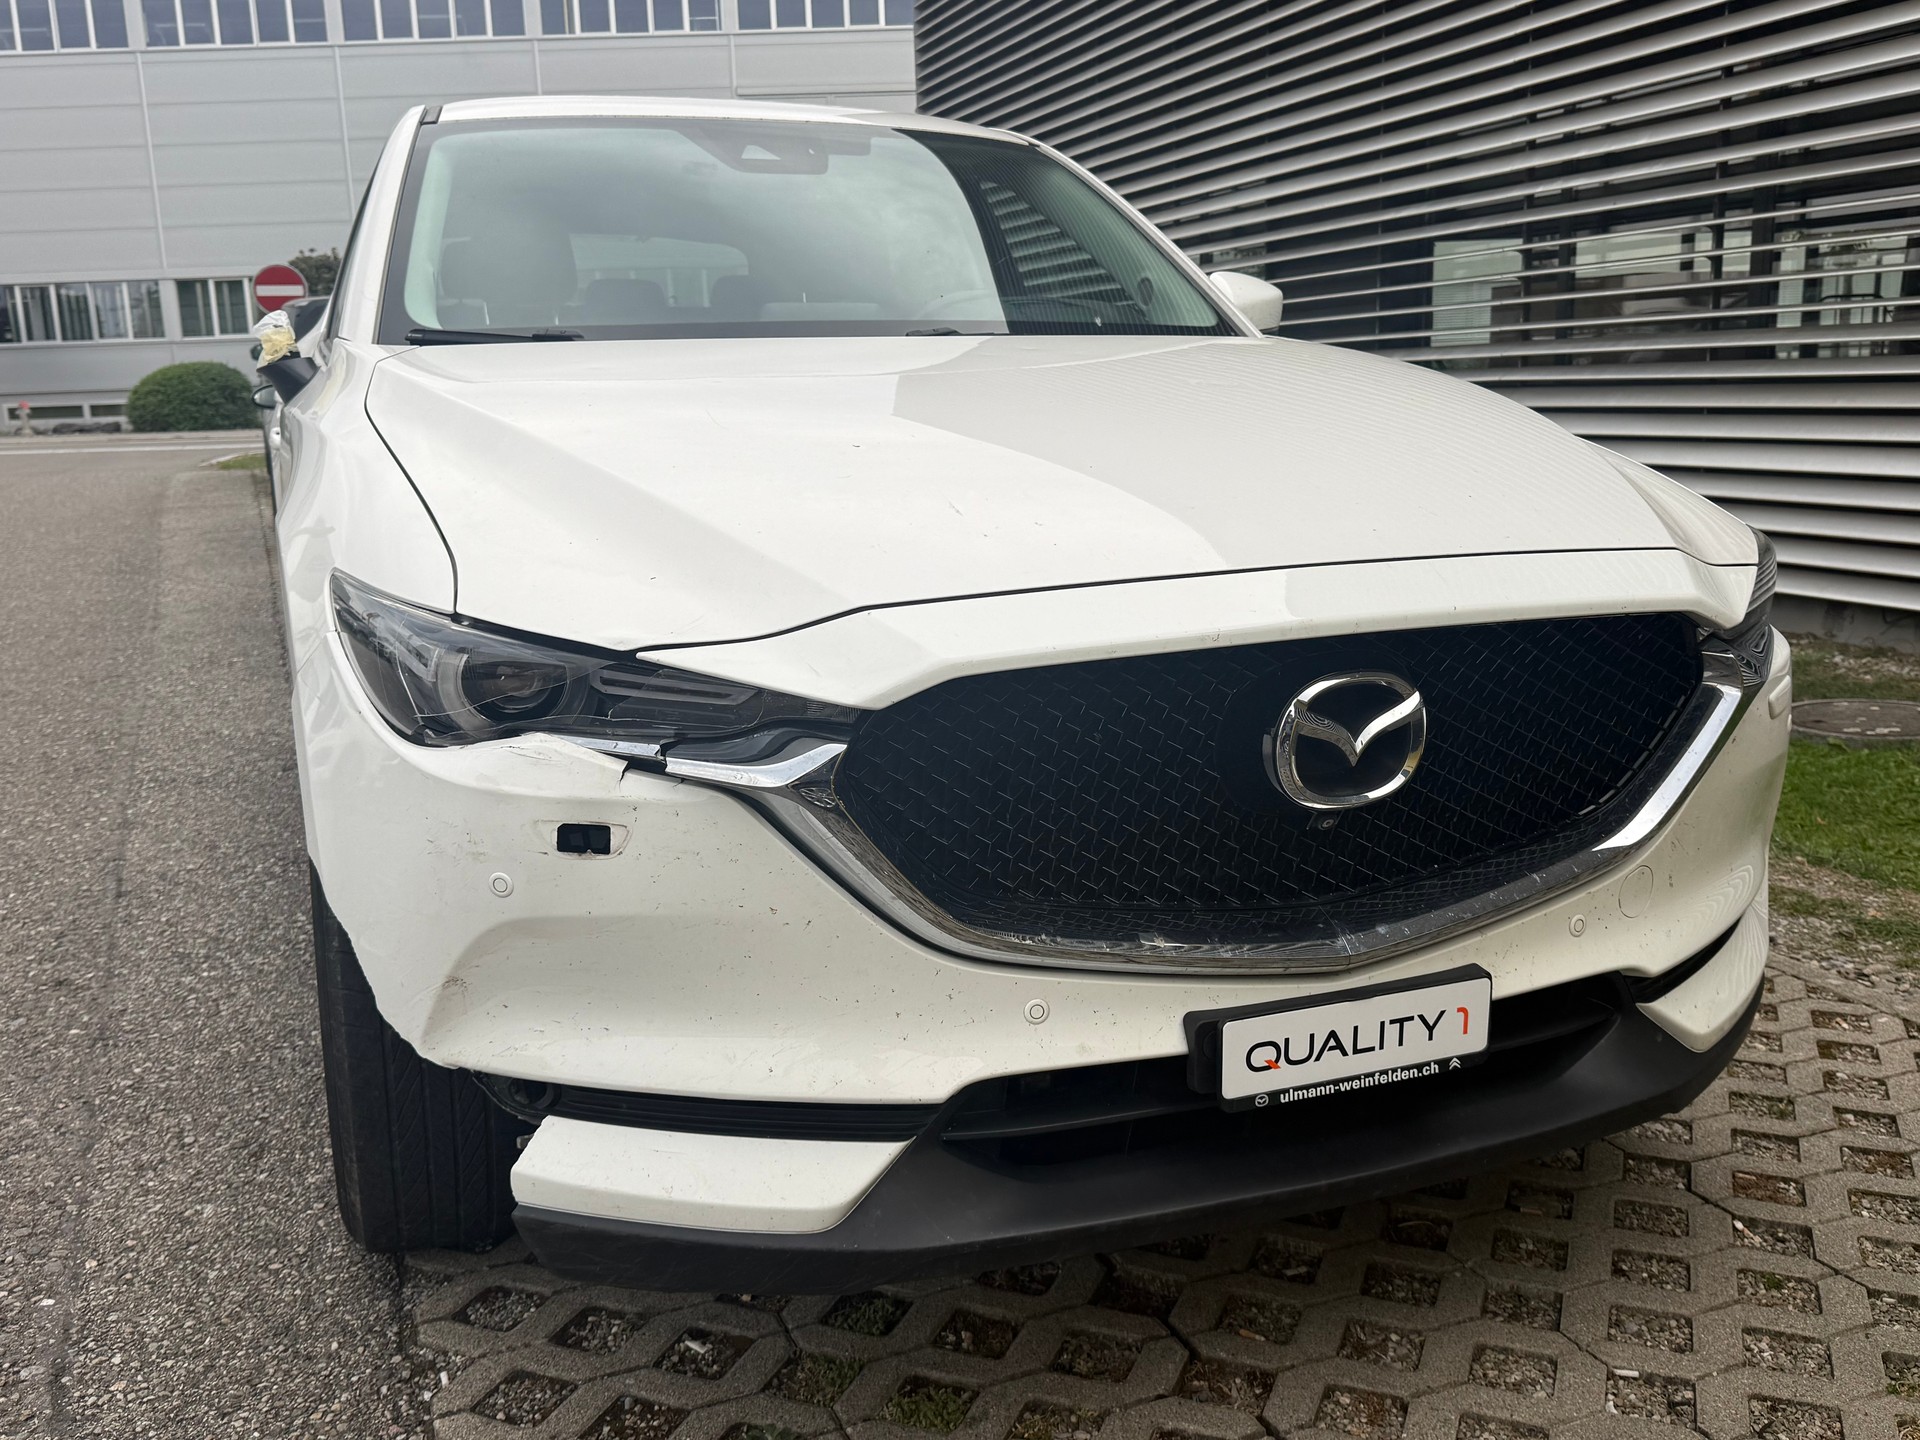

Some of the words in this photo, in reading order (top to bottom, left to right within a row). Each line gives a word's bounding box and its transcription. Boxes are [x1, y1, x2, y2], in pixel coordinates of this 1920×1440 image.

[1246, 1010, 1446, 1072] QUALITY
[1456, 1006, 1469, 1035] 1
[1280, 1062, 1439, 1103] ulmann-weinfelden.ch
